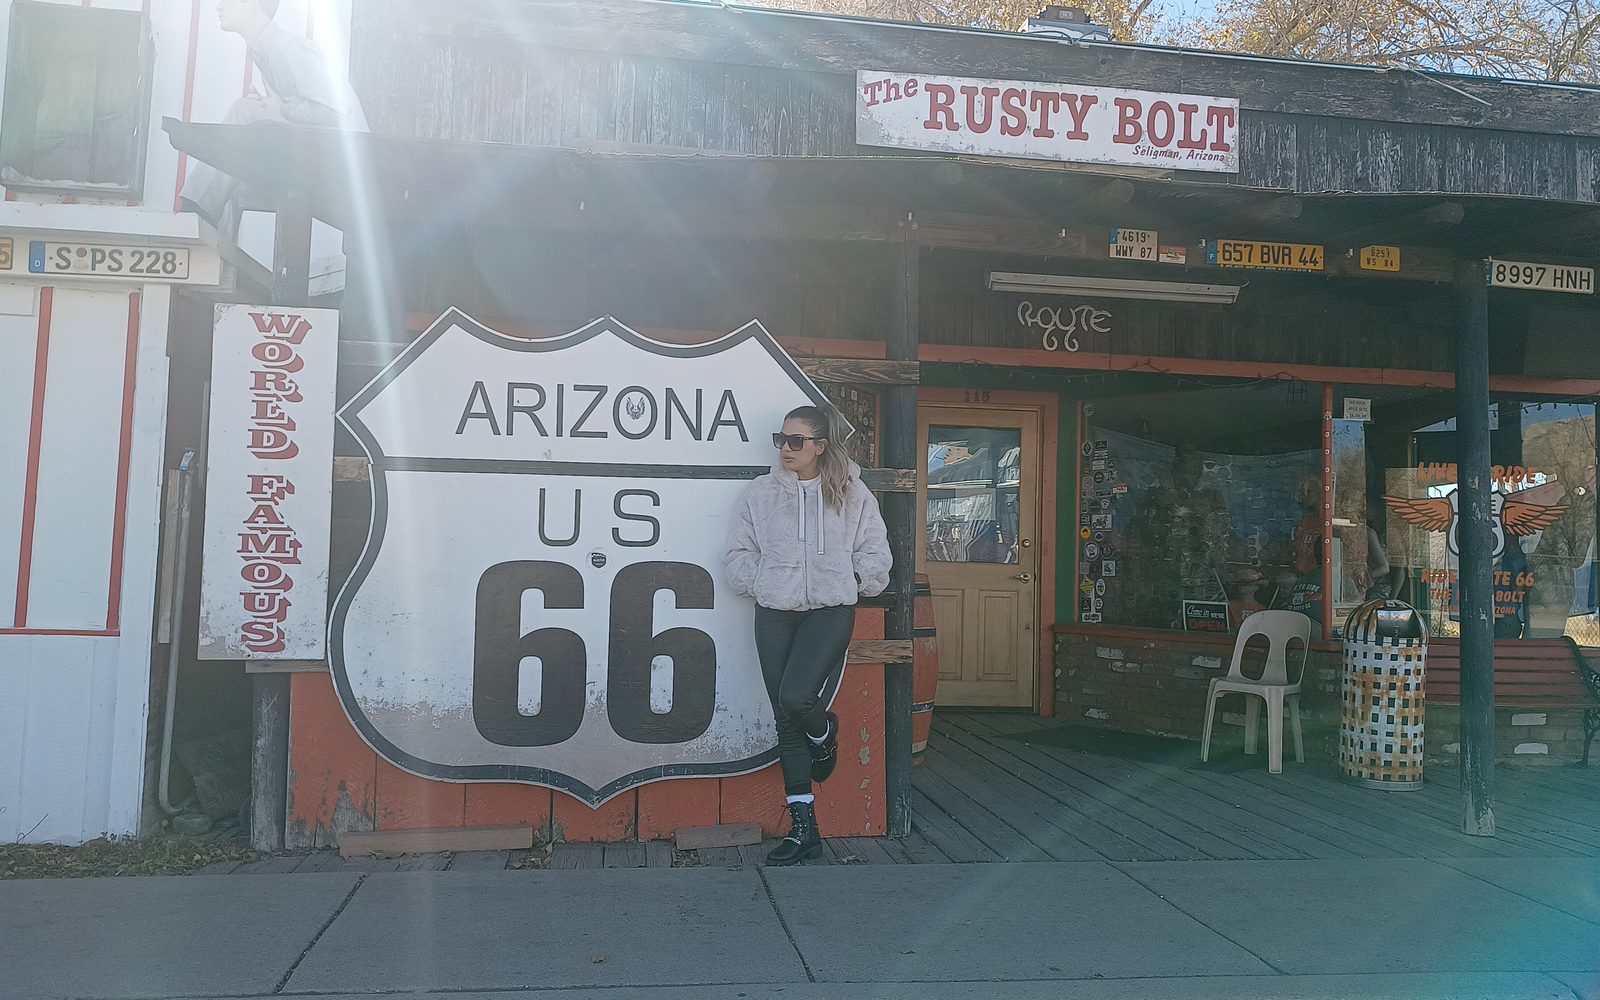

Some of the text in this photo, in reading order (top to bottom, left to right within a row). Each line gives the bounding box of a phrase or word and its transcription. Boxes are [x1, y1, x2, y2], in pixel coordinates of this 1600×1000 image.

[864, 78, 1235, 152] The RUSTY BOLT
[1132, 144, 1225, 162] Seligman, Arizona
[1122, 230, 1146, 243] 4619
[129, 250, 177, 275] 228
[1140, 247, 1152, 259] 87
[1222, 242, 1319, 267] 657 BVR 44
[1496, 263, 1591, 290] 8997 HNH
[1042, 326, 1080, 352] 66
[246, 312, 313, 460] WORLD
[455, 380, 750, 443] ARIZONA
[1417, 461, 1537, 484] LIVE RIDE
[237, 475, 303, 653] FAMOUS
[1515, 570, 1535, 587] 66
[1495, 590, 1526, 603] BOLT
[472, 559, 718, 748] 66
